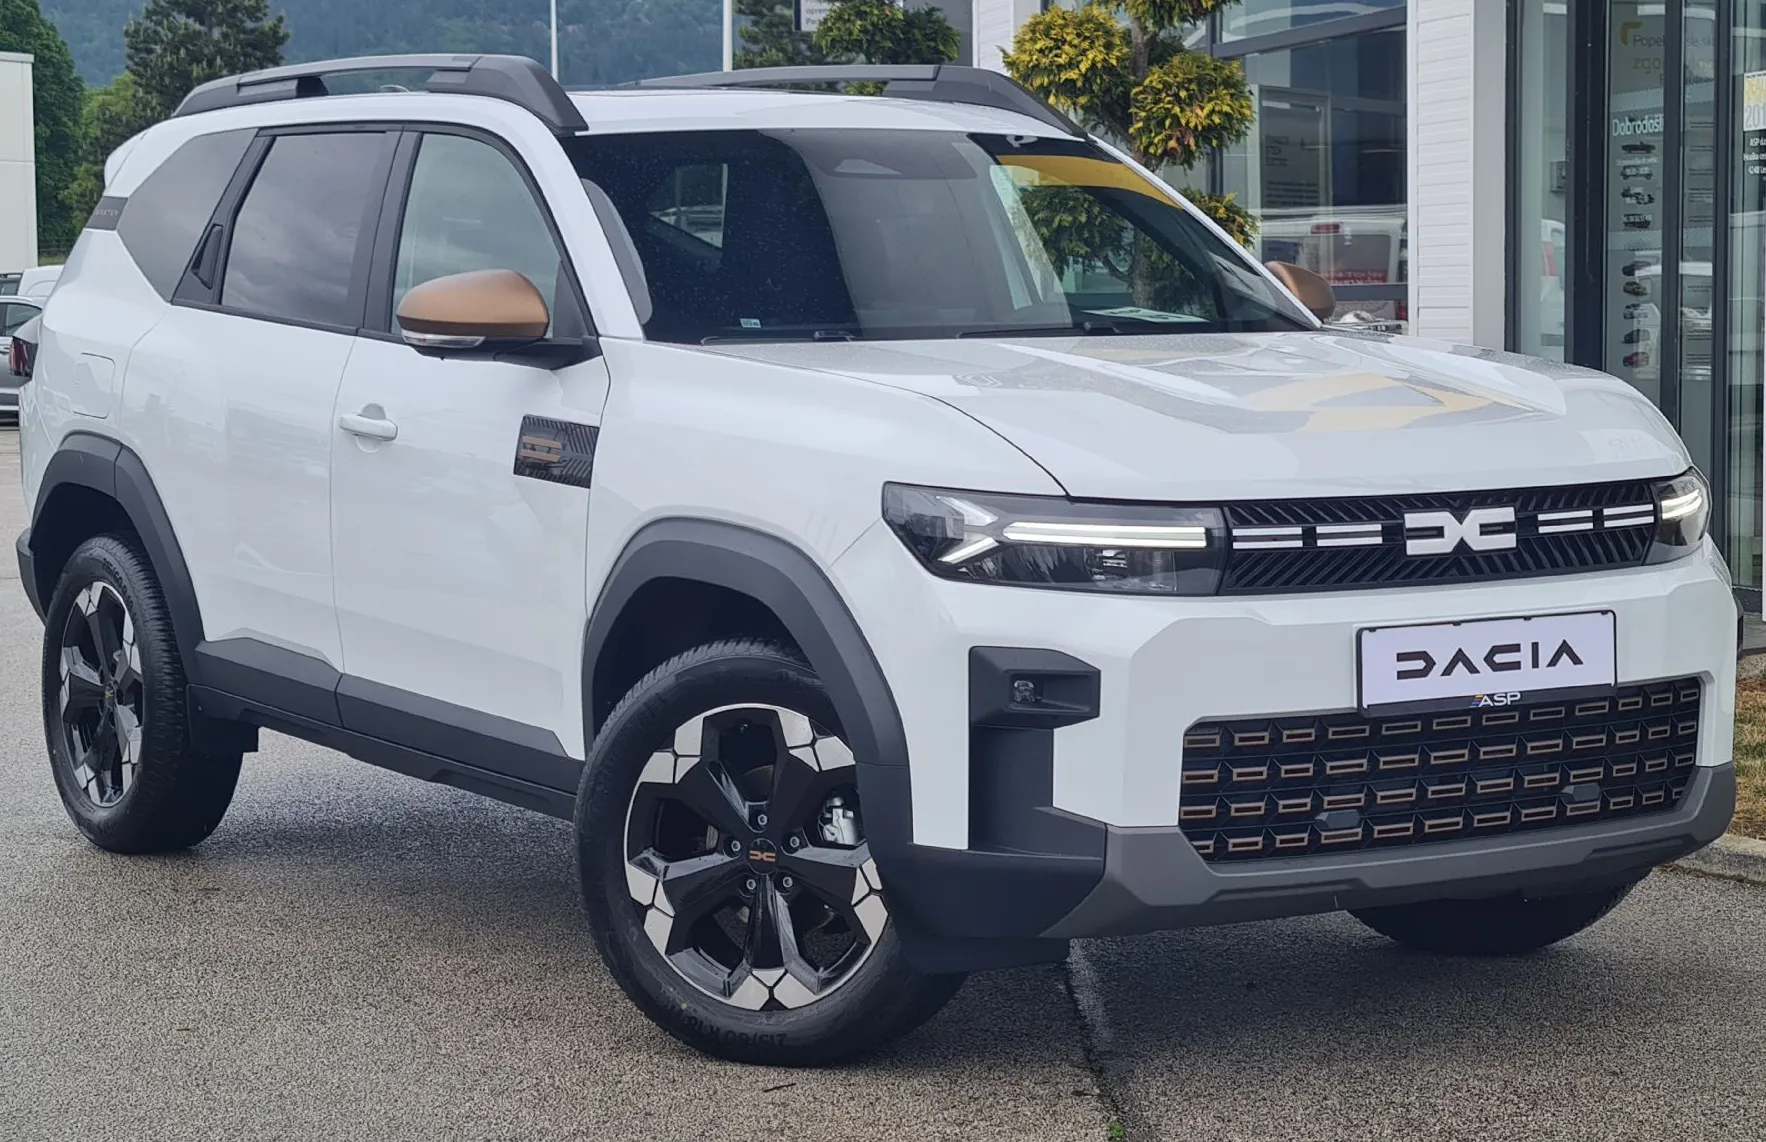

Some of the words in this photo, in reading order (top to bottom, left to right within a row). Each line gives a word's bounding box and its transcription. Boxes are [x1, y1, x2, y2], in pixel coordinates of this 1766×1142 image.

[1612, 114, 1664, 136] Dobrodošli
[1396, 639, 1584, 681] DACIA
[1478, 691, 1521, 708] ASP
